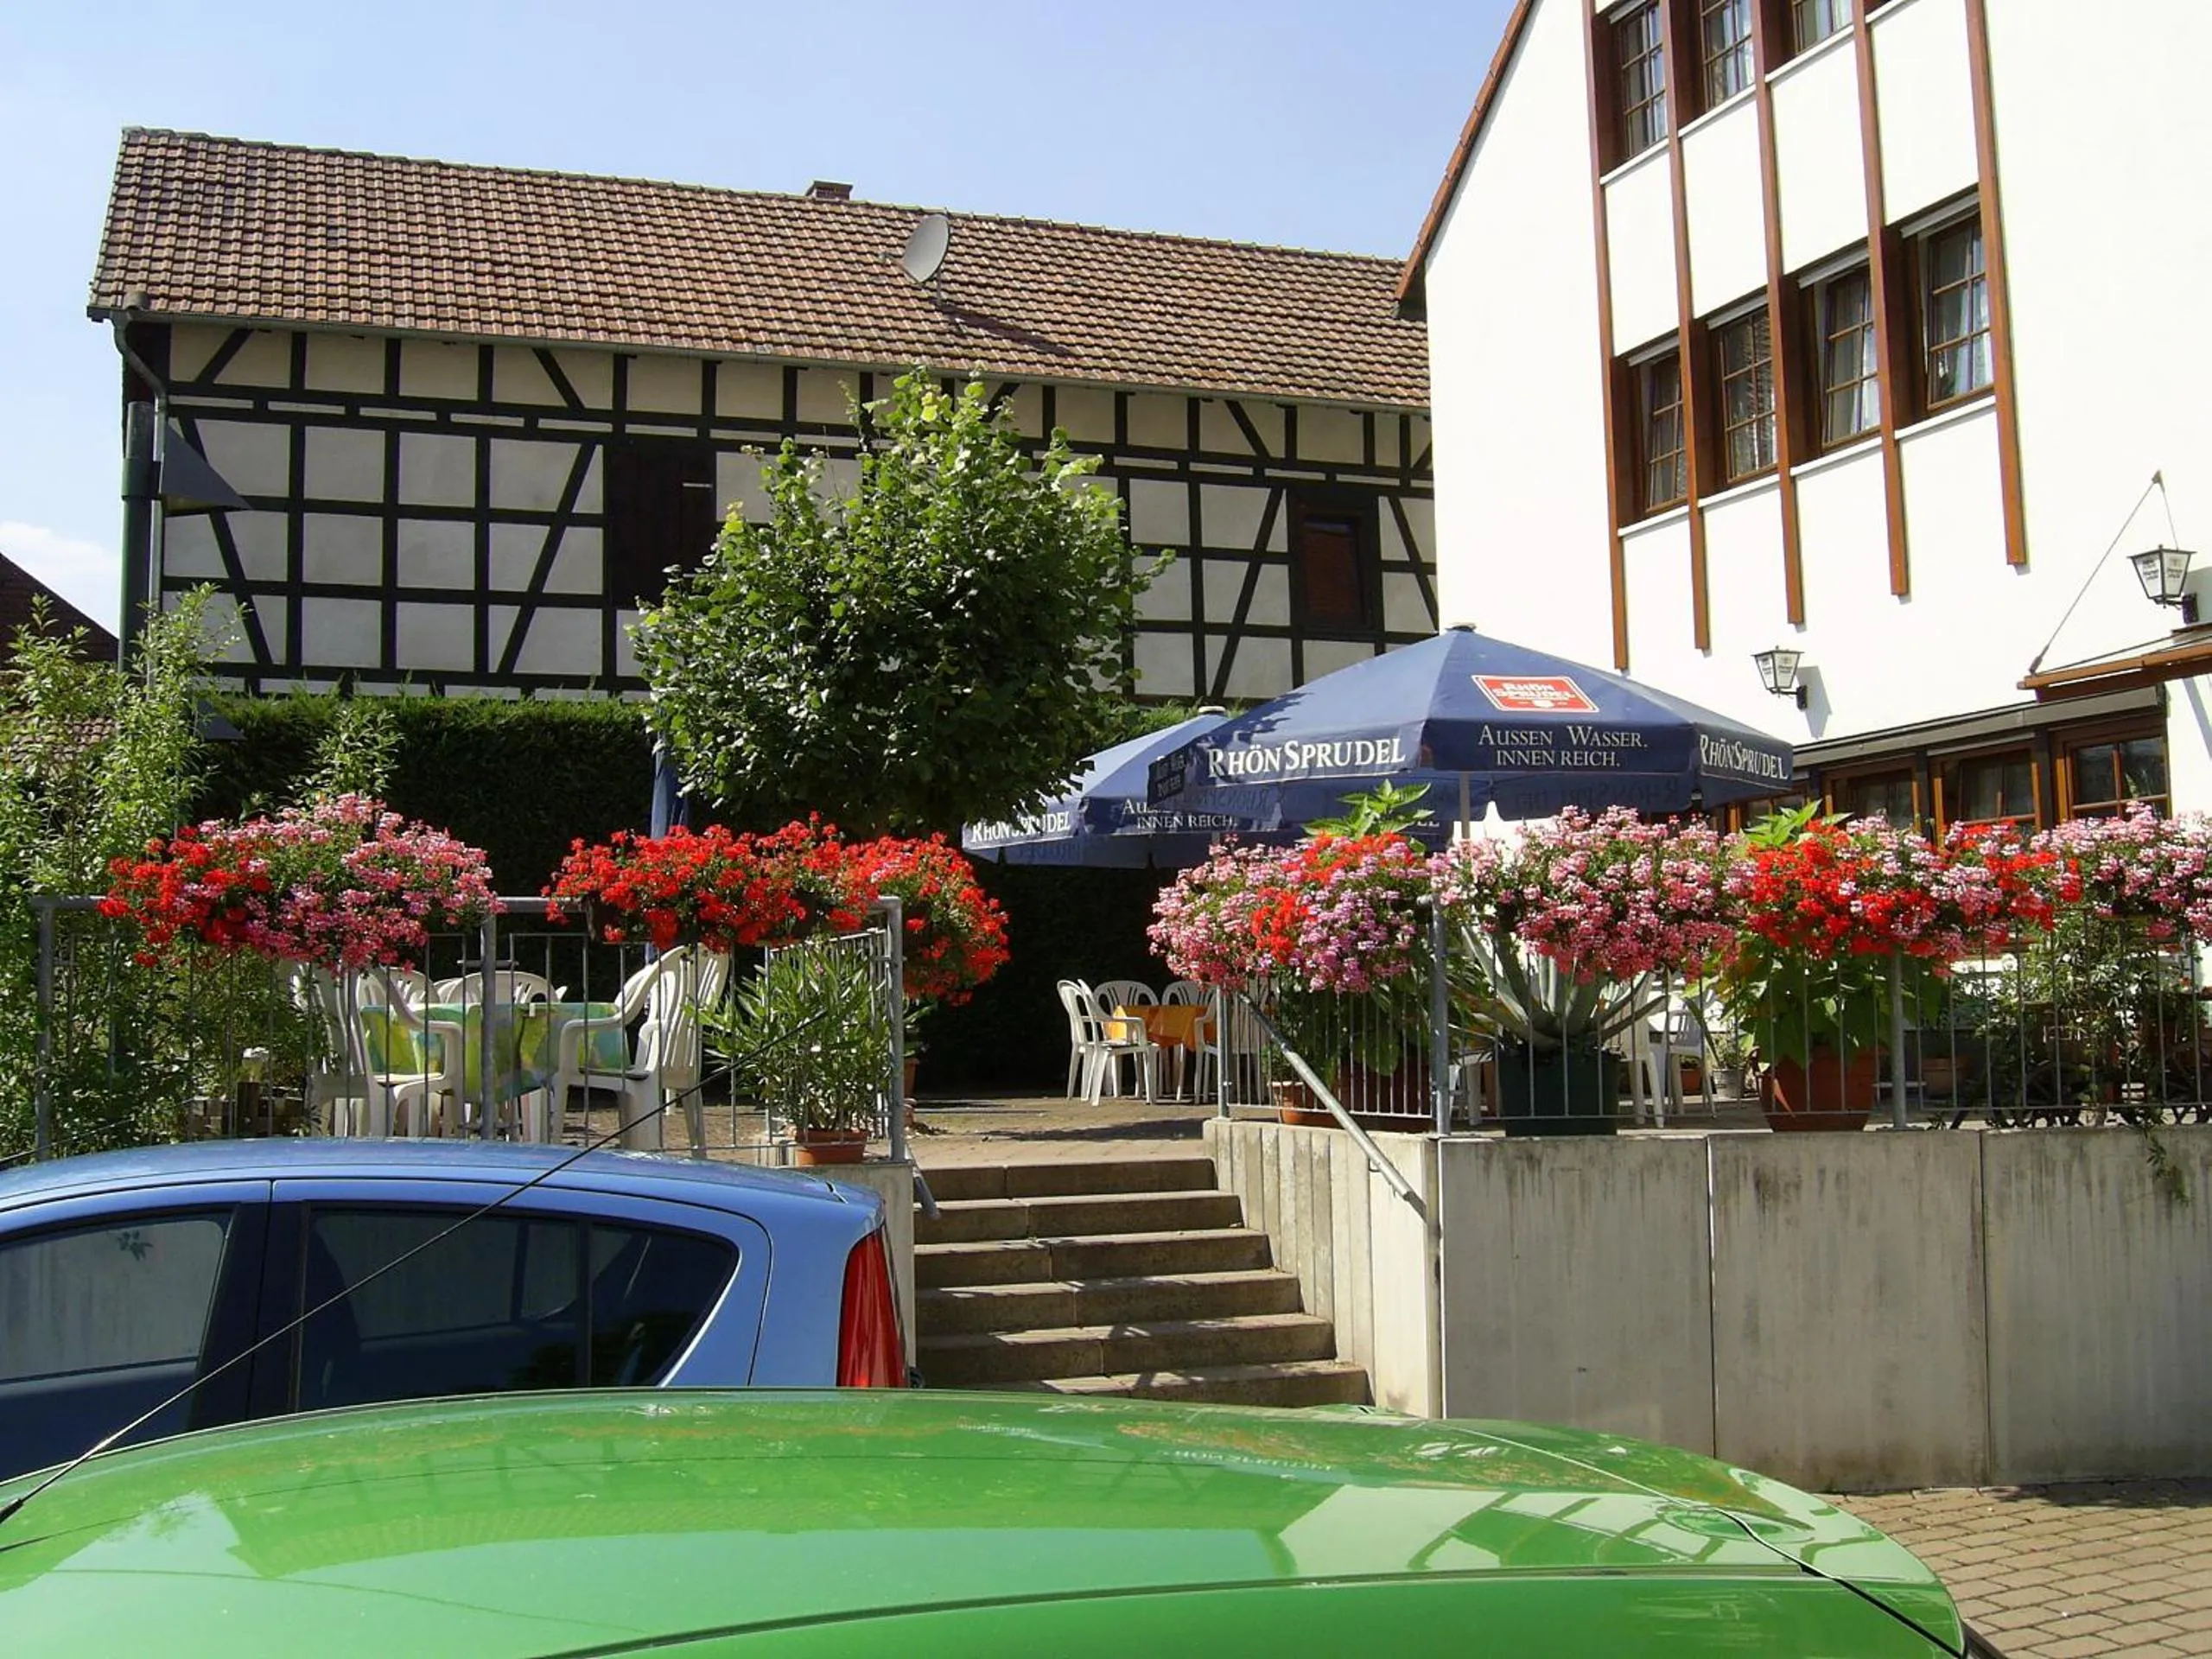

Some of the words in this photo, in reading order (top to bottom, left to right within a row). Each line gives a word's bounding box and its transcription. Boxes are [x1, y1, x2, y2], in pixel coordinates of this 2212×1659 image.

[1478, 724, 1554, 746] AUSSEN
[1567, 725, 1649, 747] WASSER.
[1497, 749, 1555, 766] INNEN
[1560, 750, 1621, 767] REICH.
[1136, 815, 1185, 830] INNEN
[1187, 815, 1238, 828] REICH.
